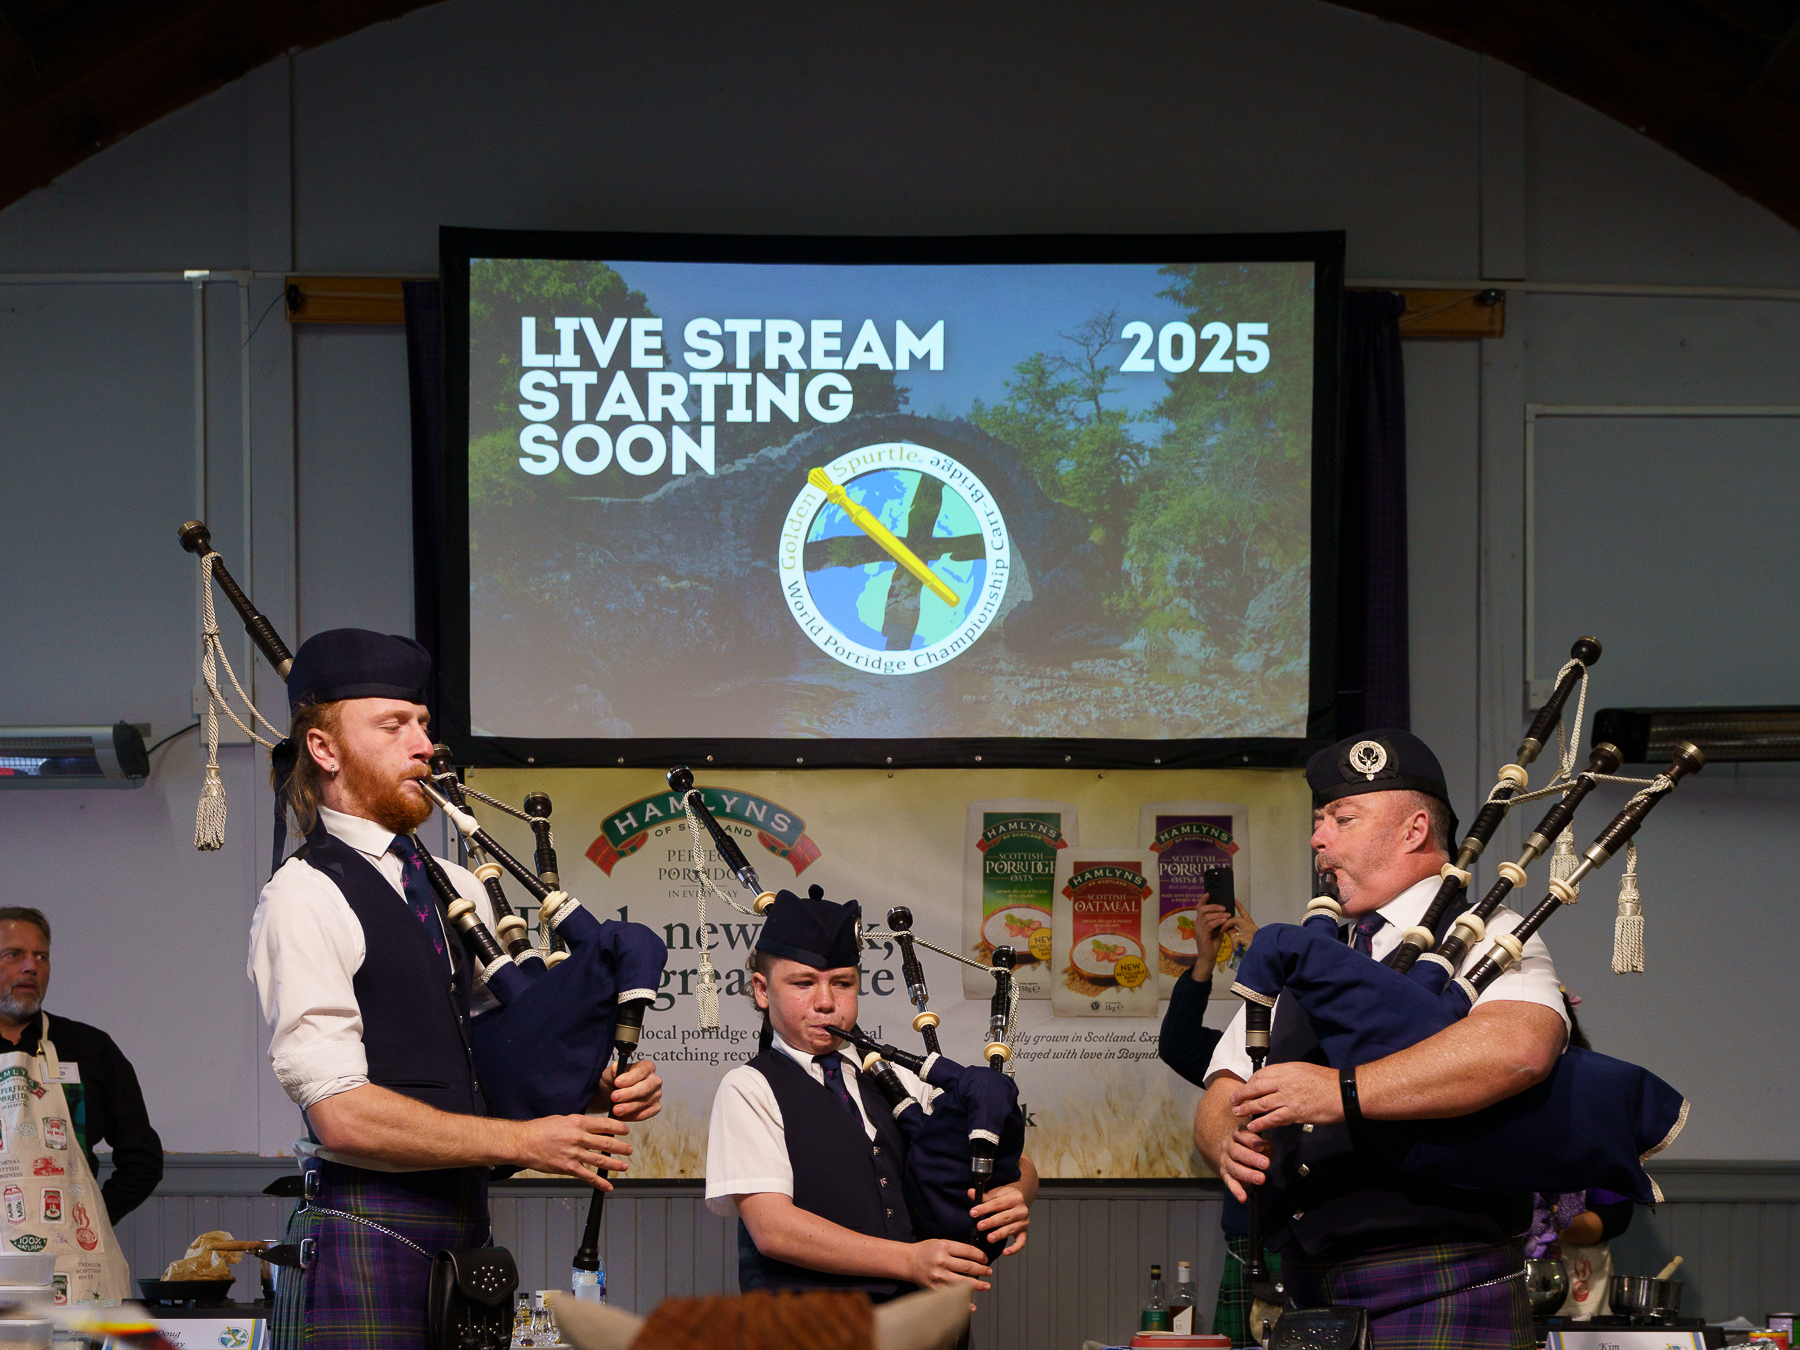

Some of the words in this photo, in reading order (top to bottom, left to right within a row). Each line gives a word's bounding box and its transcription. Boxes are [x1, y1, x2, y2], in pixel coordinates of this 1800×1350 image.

[521, 316, 664, 368] LIVE
[683, 317, 945, 370] STREAM
[1119, 320, 1271, 374] 2025
[518, 370, 854, 424] STARTING
[518, 423, 716, 476] SOON
[782, 492, 817, 570] Golden
[832, 446, 918, 478] Spurtle
[930, 455, 1004, 551] Carr-Bridge
[787, 580, 824, 637] World
[823, 634, 907, 674] Porridge
[913, 558, 1009, 669] Championship
[655, 826, 671, 837] OF
[678, 823, 753, 838] SOAND
[987, 821, 1057, 839] HAMLYNS
[1160, 825, 1228, 842] HAMLYNS
[999, 852, 1043, 860] SCOTTISH
[1171, 855, 1216, 863] SCOTTISH
[658, 867, 737, 883] PORIDG
[1010, 874, 1033, 882] OATS
[1072, 868, 1142, 886] HAMLYNS
[1171, 876, 1192, 884] OATS
[668, 890, 680, 898] IN
[1087, 893, 1126, 901] SCOTTISH
[1074, 901, 1139, 912] OATMEAL
[663, 923, 763, 950] new
[1034, 936, 1052, 944] NEW
[1120, 963, 1141, 971] NEW
[648, 968, 748, 1011] gra
[1105, 1003, 1117, 1012] 1kg
[641, 1024, 677, 1040] local
[681, 1024, 748, 1044] porridge
[984, 1031, 1031, 1046] Poudly
[1033, 1034, 1069, 1046] grown
[1071, 1032, 1083, 1043] in
[1085, 1031, 1136, 1043] Scotland.
[629, 1046, 720, 1066] ye-catching
[1014, 1048, 1052, 1062] kaged
[1052, 1048, 1078, 1060] with
[1079, 1048, 1103, 1060] love
[1104, 1048, 1116, 1060] in
[1117, 1048, 1160, 1062] Boynd
[1, 1084, 29, 1095] PERFEC
[20, 1236, 42, 1245] 100%
[158, 1329, 182, 1340] Doug
